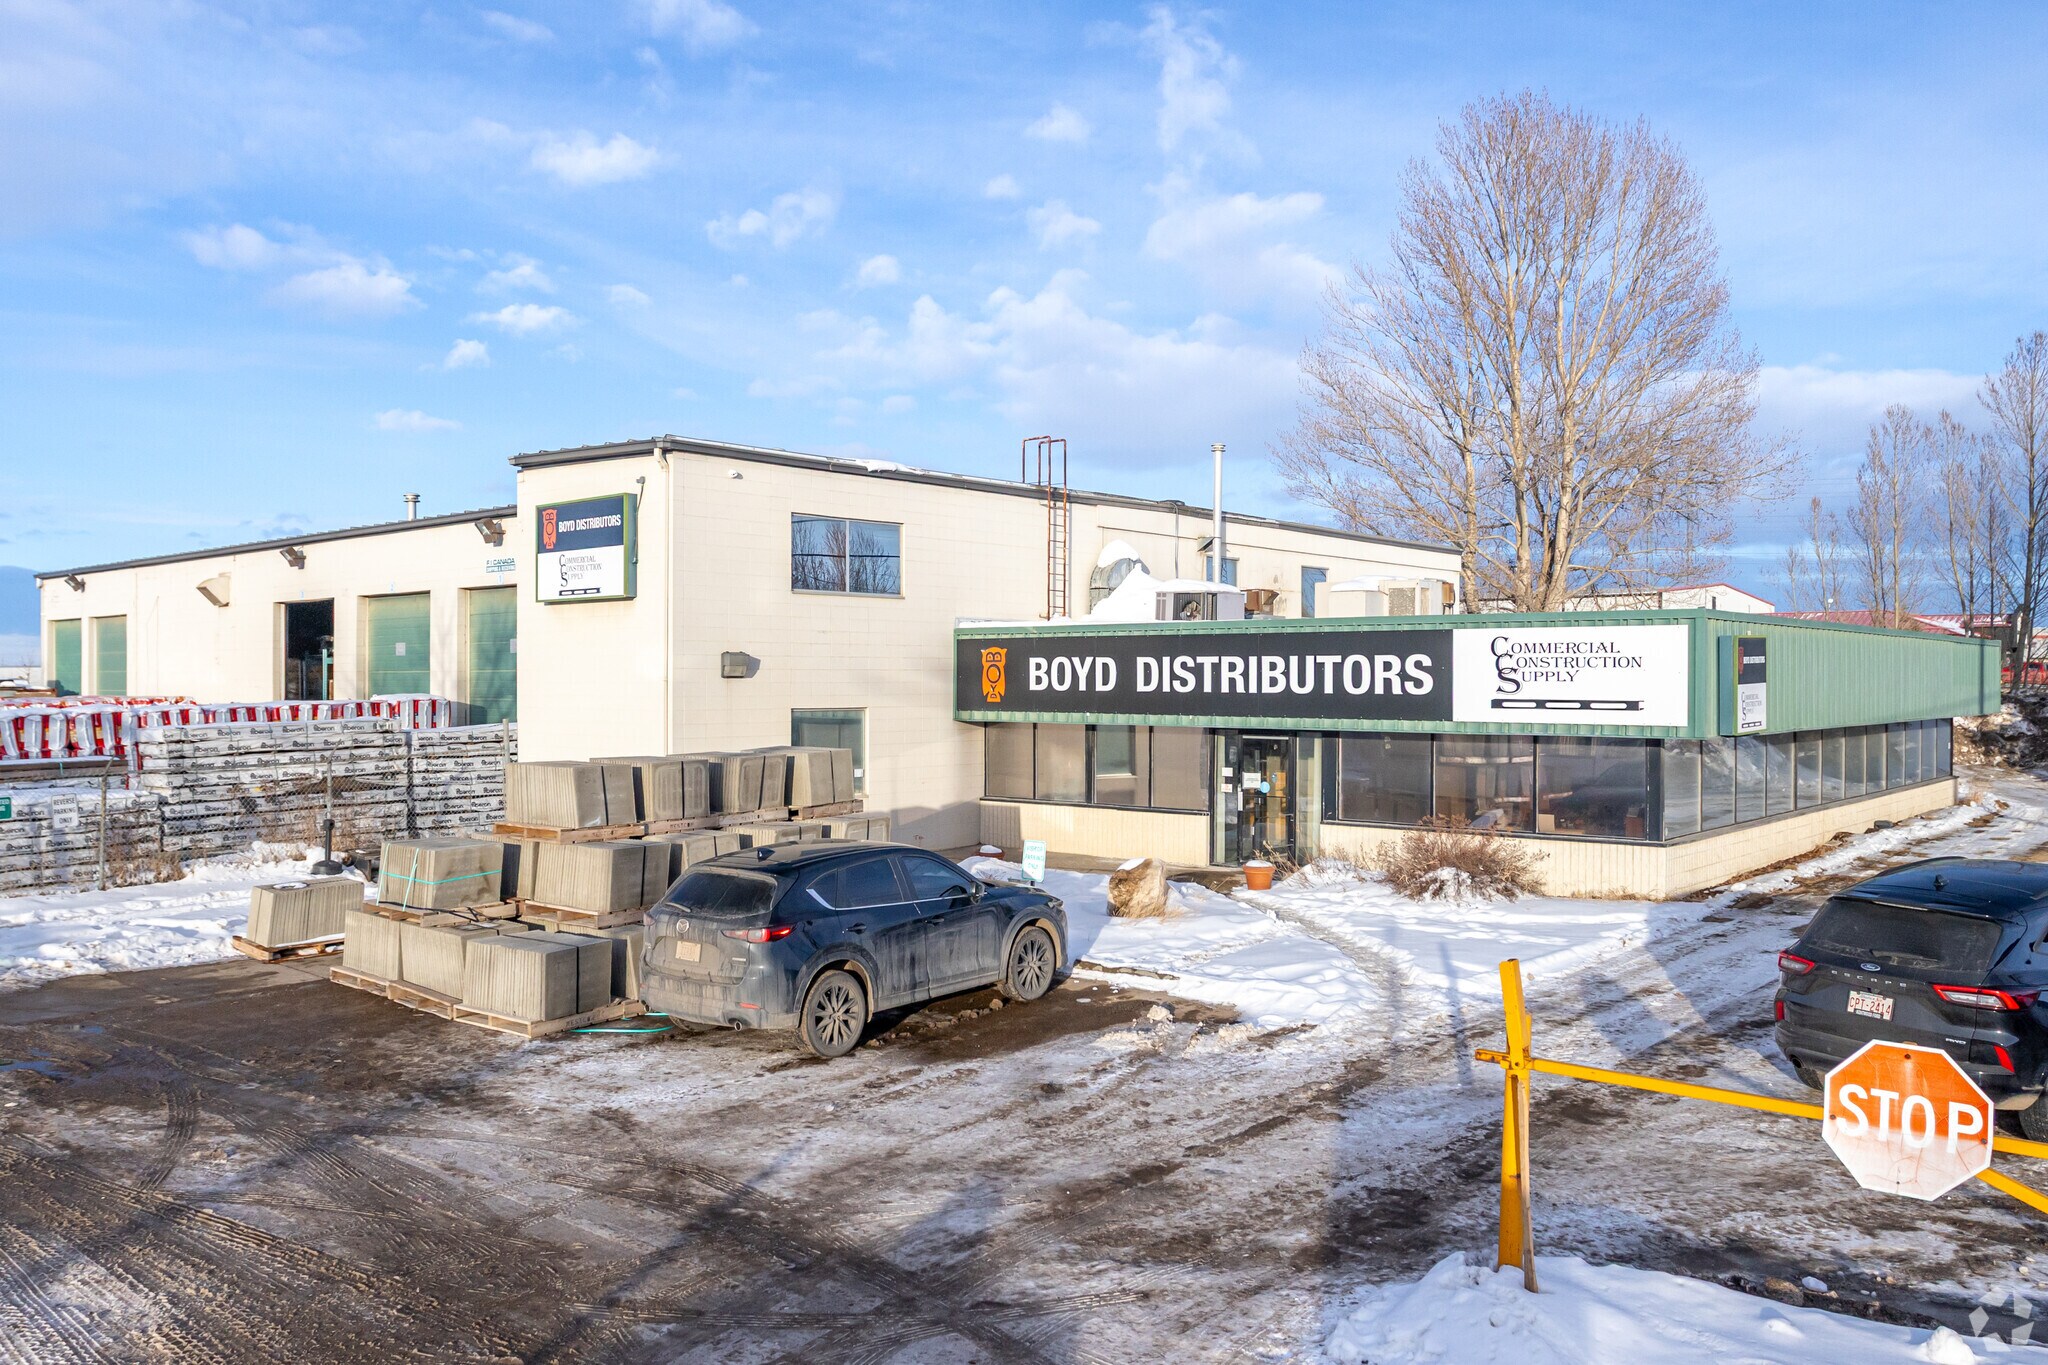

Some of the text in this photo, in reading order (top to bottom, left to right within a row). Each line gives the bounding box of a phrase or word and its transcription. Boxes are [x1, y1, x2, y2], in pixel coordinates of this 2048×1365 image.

[558, 514, 622, 533] BOYD DISTRIBUTORS
[559, 554, 596, 566] COMMERCIAL
[1490, 636, 1621, 658] COMMERCIAL
[1028, 653, 1434, 696] BOYD DISTRIBUTORS
[1494, 652, 1642, 675] CONSTRUCTION
[1496, 667, 1580, 694] SUPPLY
[54, 798, 75, 806] REVERSE
[1831, 970, 1907, 988] ESCAPE
[1836, 1083, 1984, 1154] STOP
